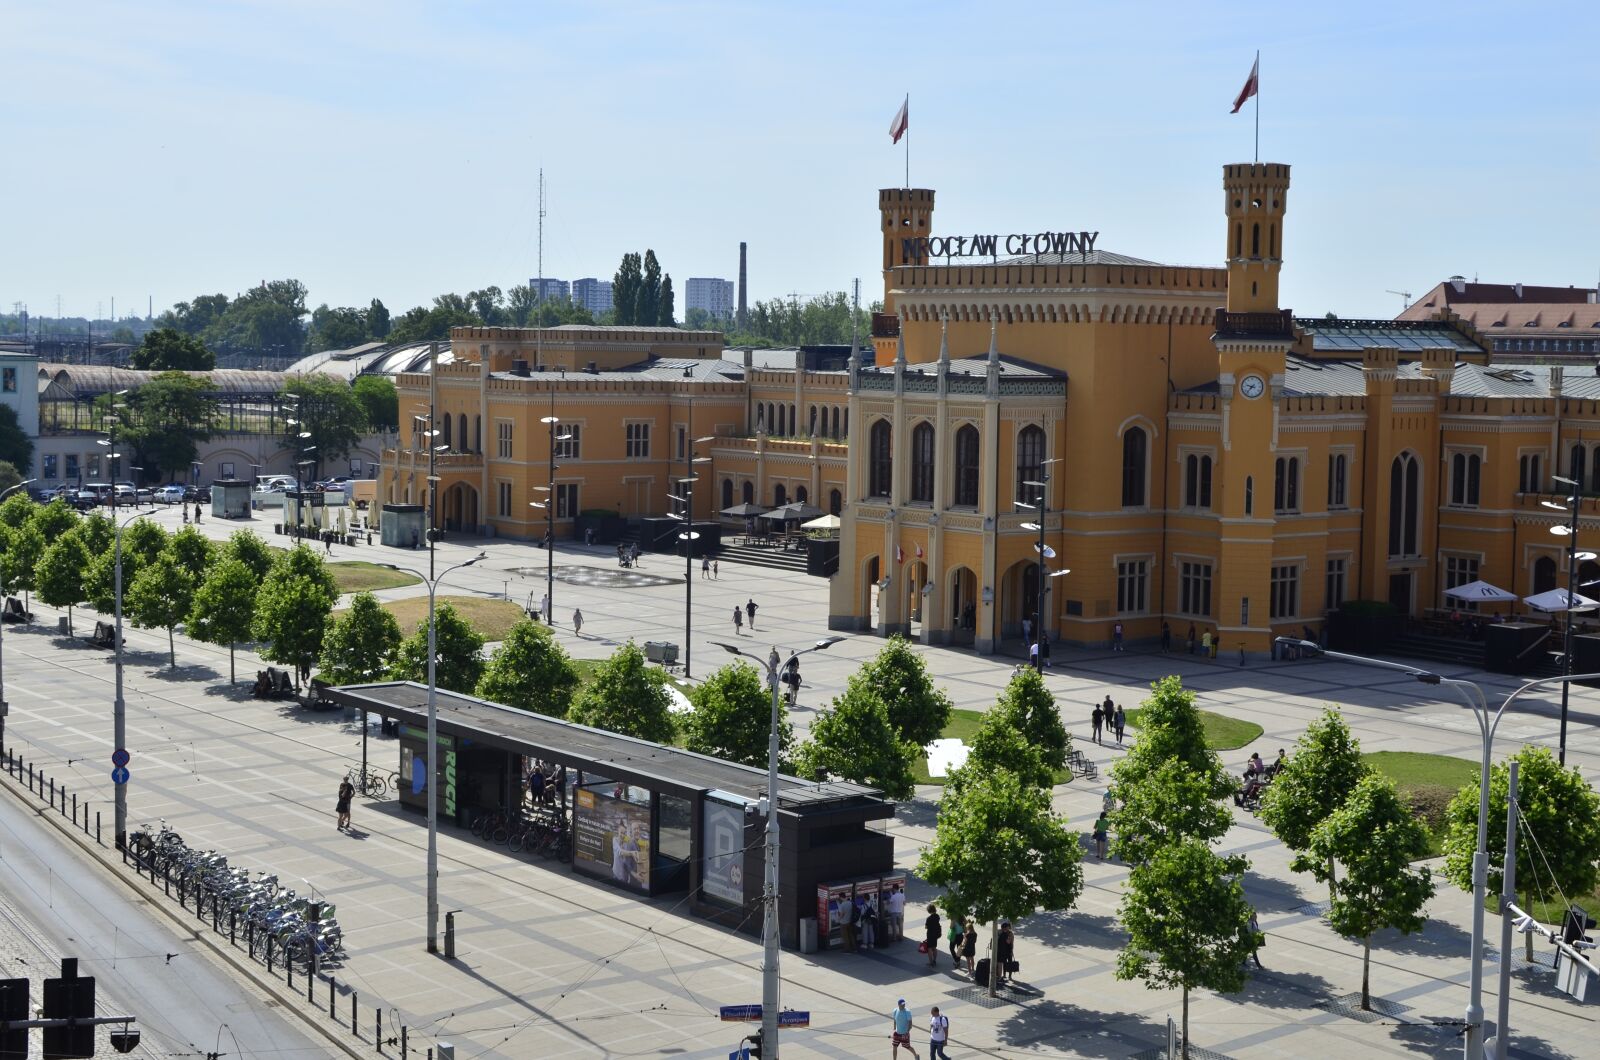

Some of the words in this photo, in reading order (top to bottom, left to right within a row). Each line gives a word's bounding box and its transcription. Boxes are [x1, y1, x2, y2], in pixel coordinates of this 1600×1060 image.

[902, 234, 998, 257] WROCŁAW
[1006, 231, 1099, 255] GŁÓWNY
[445, 750, 457, 817] RUCH
